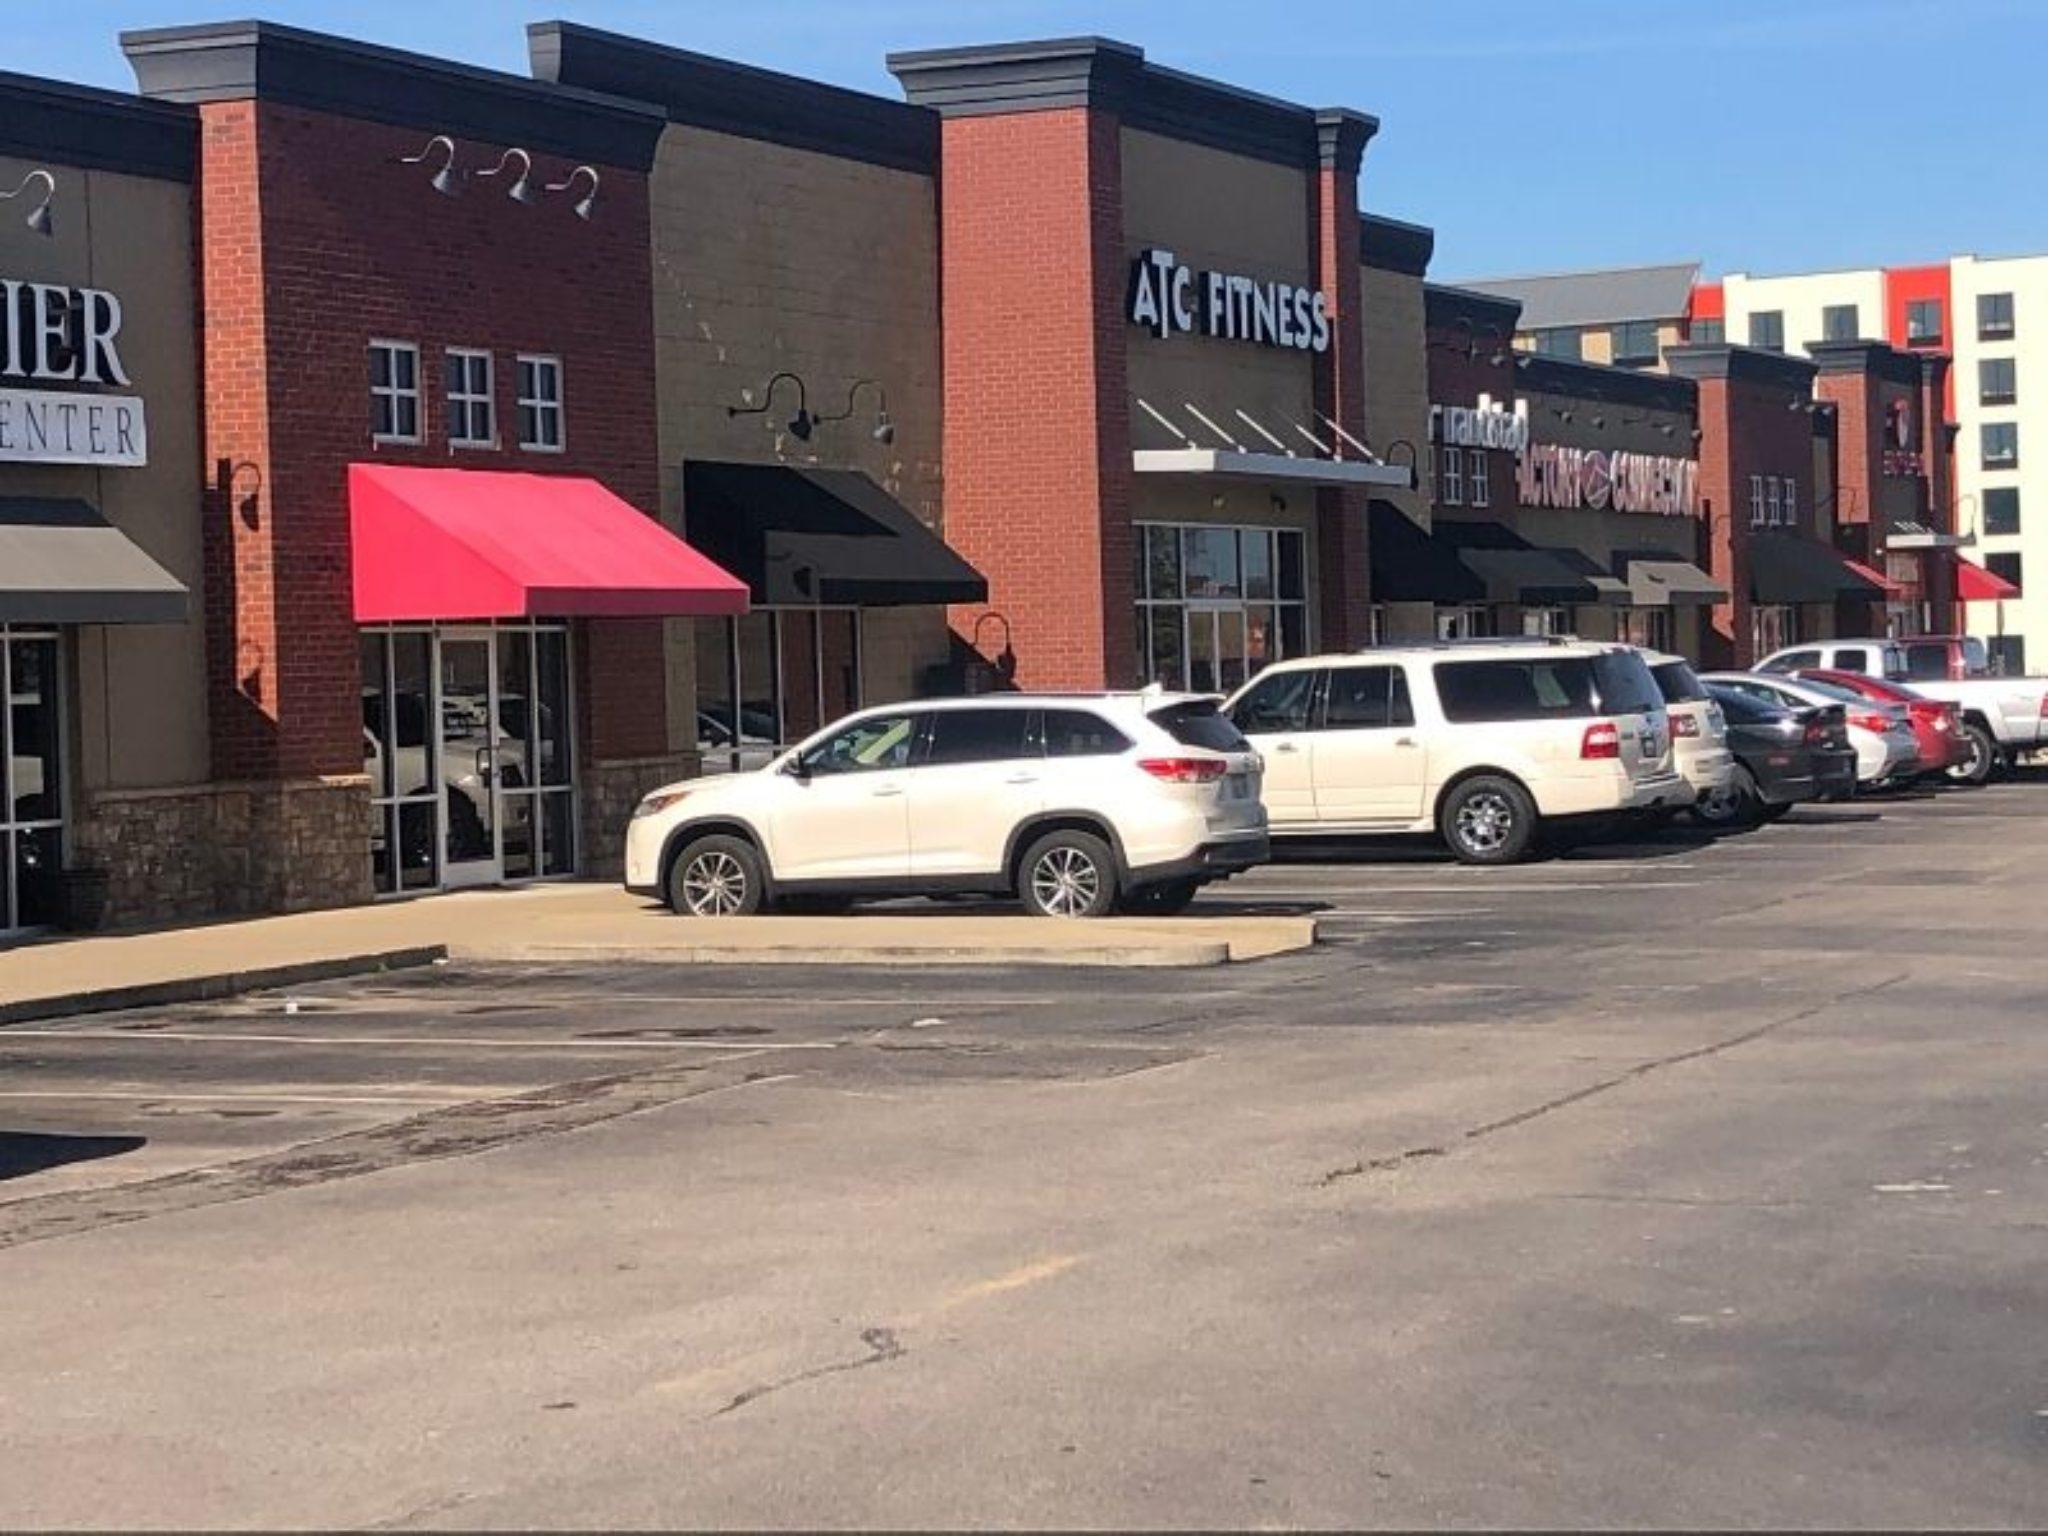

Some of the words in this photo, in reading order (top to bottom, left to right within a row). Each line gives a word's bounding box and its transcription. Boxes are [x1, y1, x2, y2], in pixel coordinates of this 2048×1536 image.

[0, 278, 131, 387] IER
[1133, 250, 1192, 339] ATC
[1207, 270, 1329, 351] FITNESS
